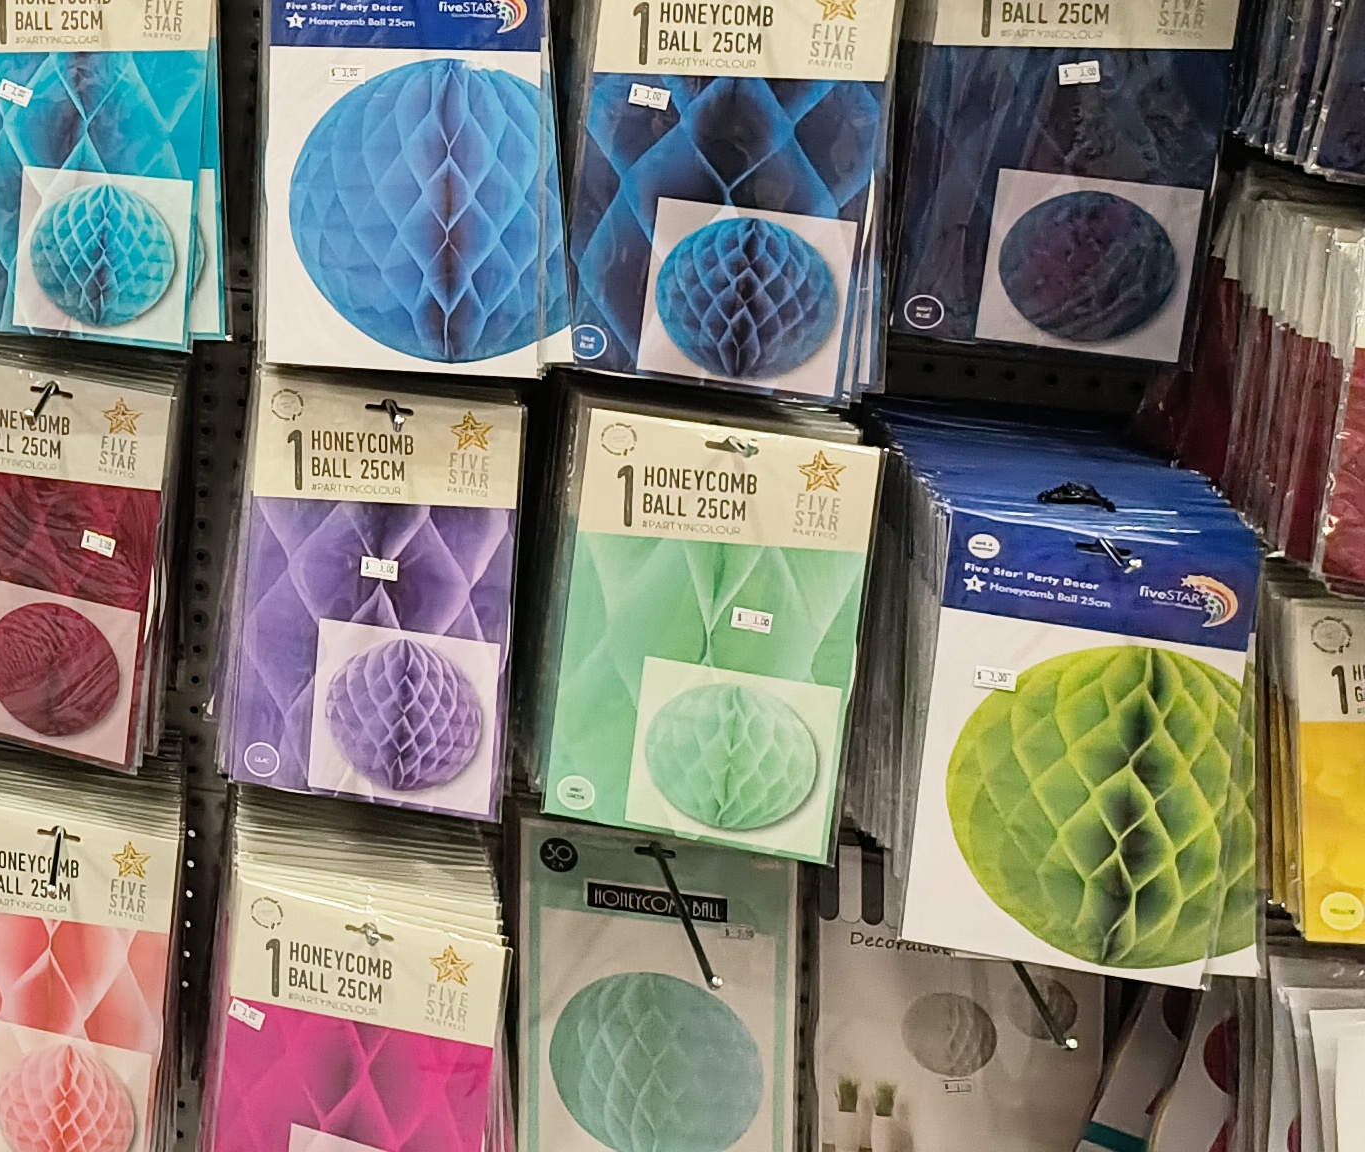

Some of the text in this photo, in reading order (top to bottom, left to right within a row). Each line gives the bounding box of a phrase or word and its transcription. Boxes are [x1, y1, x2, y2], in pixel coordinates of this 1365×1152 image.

[15, 9, 104, 32] BALL 25CM
[286, 1, 306, 12] Five
[340, 2, 369, 15] Party
[371, 2, 404, 13] Decor
[309, 16, 416, 29] Honeycomb Ball 25cm
[144, 15, 182, 33] STAR
[632, 2, 774, 66] 1 HONEYCOMB
[658, 30, 763, 55] BALL 25CM
[287, 429, 414, 491] 1 HONEYCOMB
[311, 456, 405, 482] BALL 25CM
[617, 464, 759, 528] 1 HONEYCOMB
[642, 491, 748, 522] BALL 25CM
[964, 562, 989, 576] Five
[1026, 570, 1058, 586] Party
[1062, 576, 1099, 591] Decor
[990, 582, 1111, 609] Honeycomb Ball 25cm
[594, 887, 722, 920] HONEYCO BALL
[264, 939, 393, 999] 1 HONEYCOMB
[288, 966, 383, 1005] BALL 25CM
